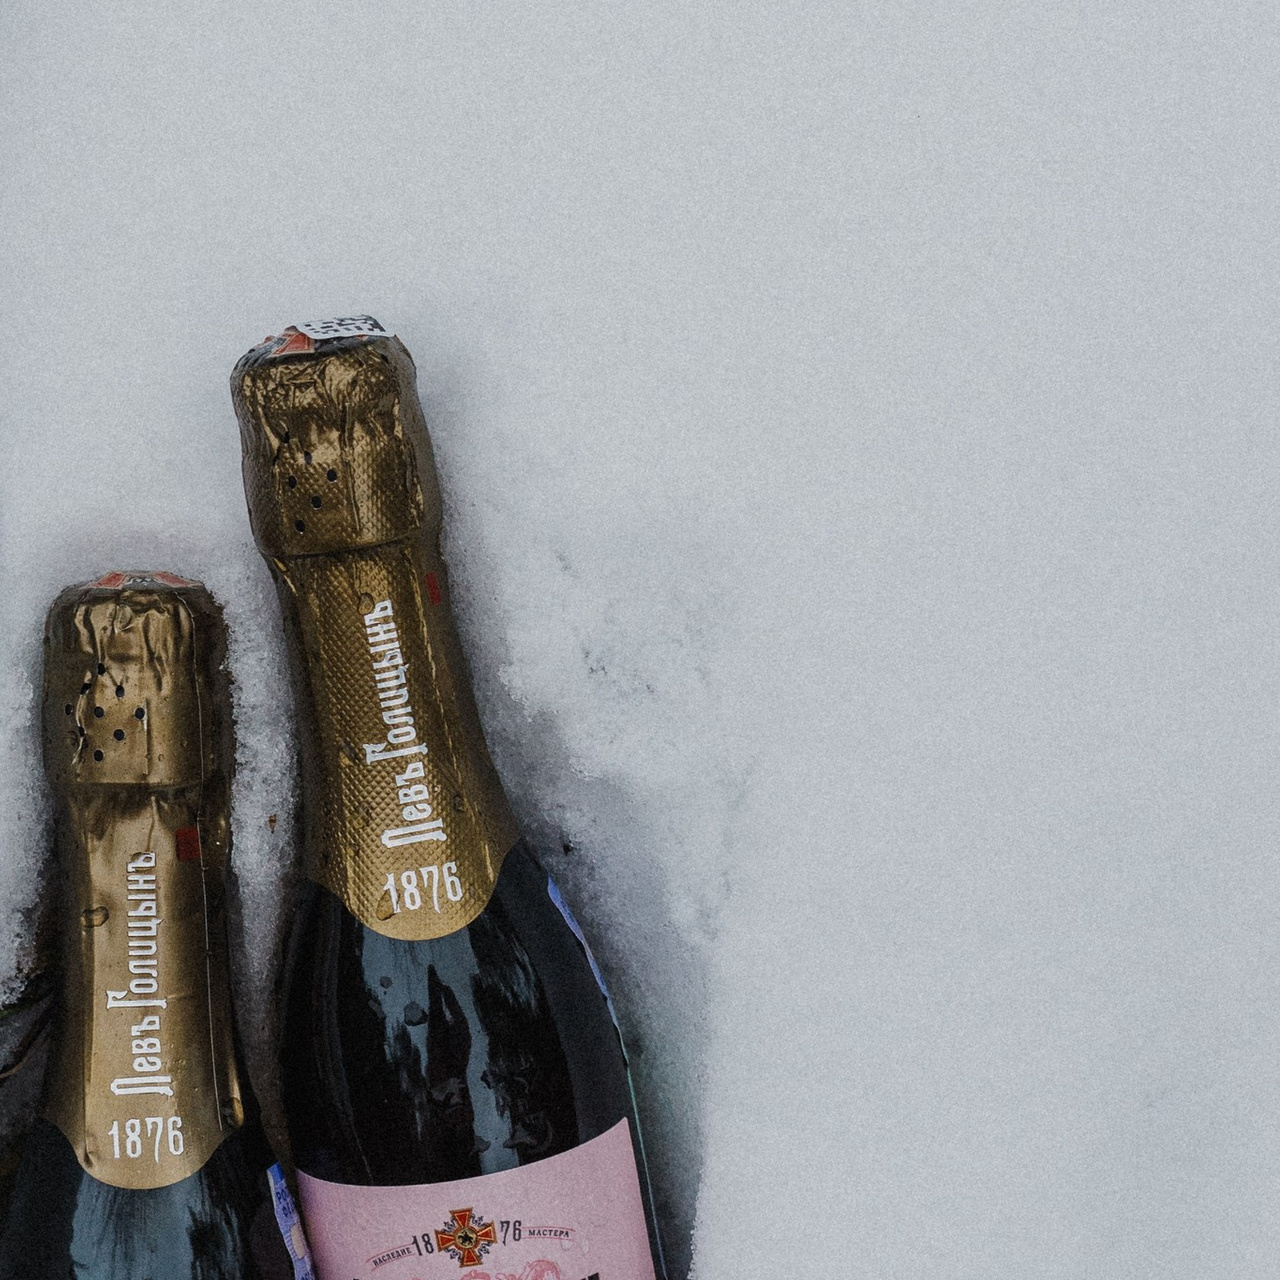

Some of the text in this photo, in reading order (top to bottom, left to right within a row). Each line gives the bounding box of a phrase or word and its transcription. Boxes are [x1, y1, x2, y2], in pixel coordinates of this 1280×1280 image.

[363, 598, 447, 848] Левъ Голицынъ
[383, 861, 464, 914] 1876
[106, 851, 173, 1097] Левъ Голицынъ
[108, 1116, 184, 1163] 1876
[412, 1233, 434, 1256] 18
[500, 1220, 522, 1246] 76
[528, 1229, 570, 1238] МАСТЕРА
